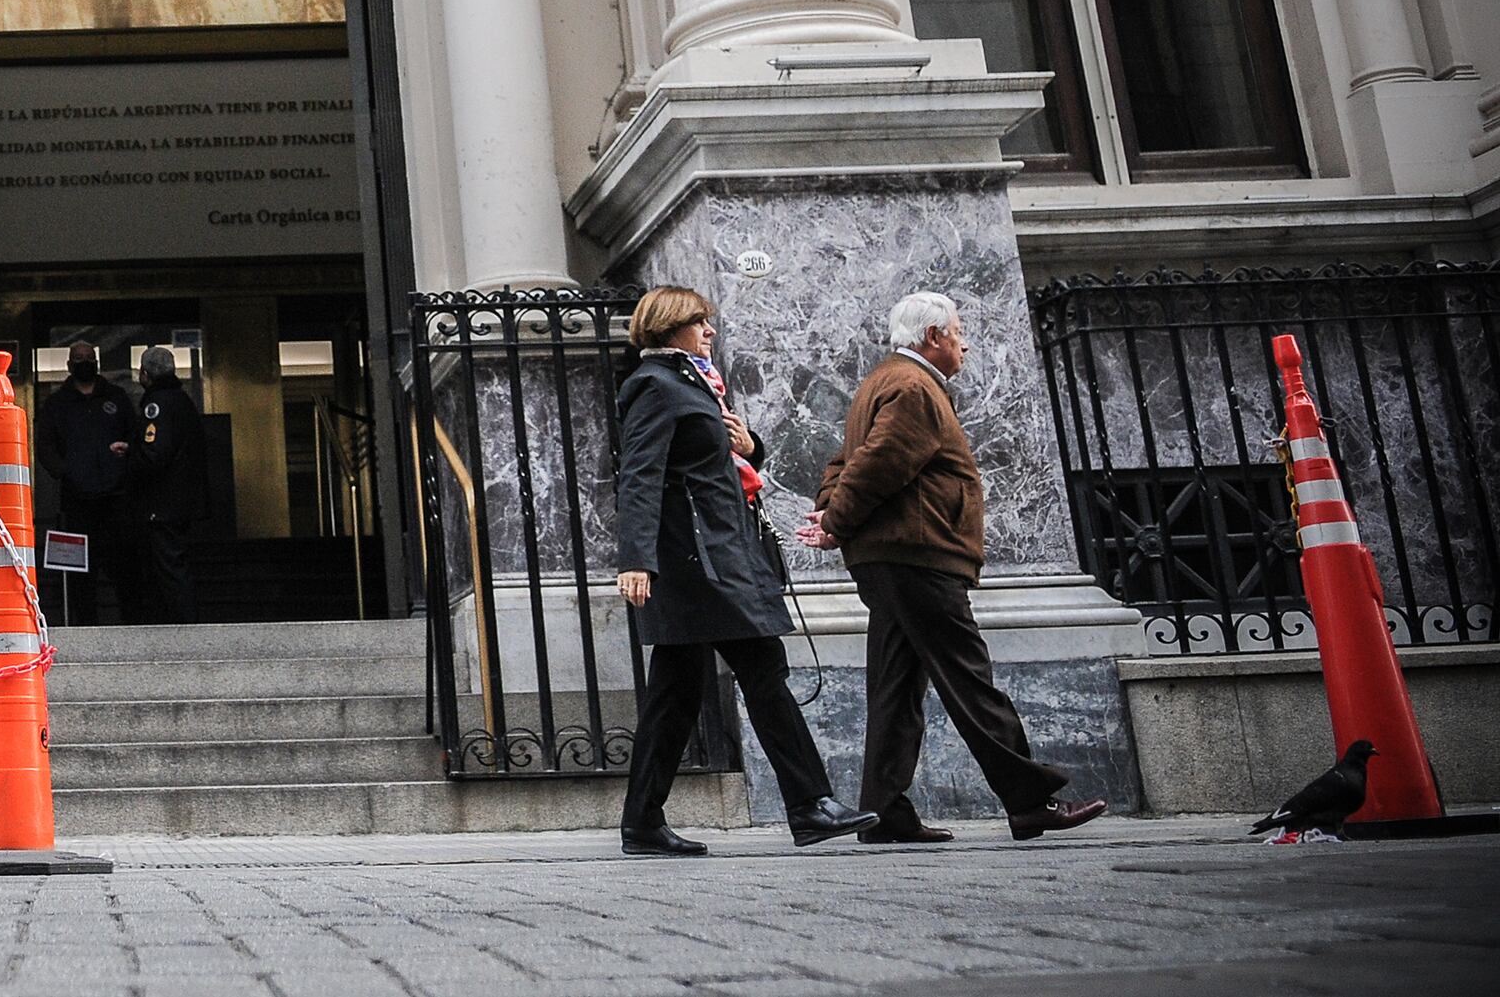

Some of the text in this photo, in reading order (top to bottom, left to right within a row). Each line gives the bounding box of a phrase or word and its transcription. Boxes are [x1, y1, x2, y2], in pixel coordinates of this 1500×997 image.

[8, 110, 29, 121] LA
[32, 105, 119, 121] REPÚBLICA
[123, 103, 213, 117] ARGENTINA
[218, 102, 262, 115] TIENE
[266, 101, 299, 113] POR
[51, 138, 147, 153] MONETARIA,
[151, 138, 171, 150] LA
[175, 135, 278, 149] ESTABILIDAD
[59, 171, 153, 187] ECONÓMICO
[158, 171, 190, 183] CON
[193, 169, 266, 185] EQUIDAD
[269, 168, 331, 180] SOCIAL.
[208, 210, 253, 225] Carta
[257, 207, 330, 228] Orgánica
[744, 256, 766, 271] 266
